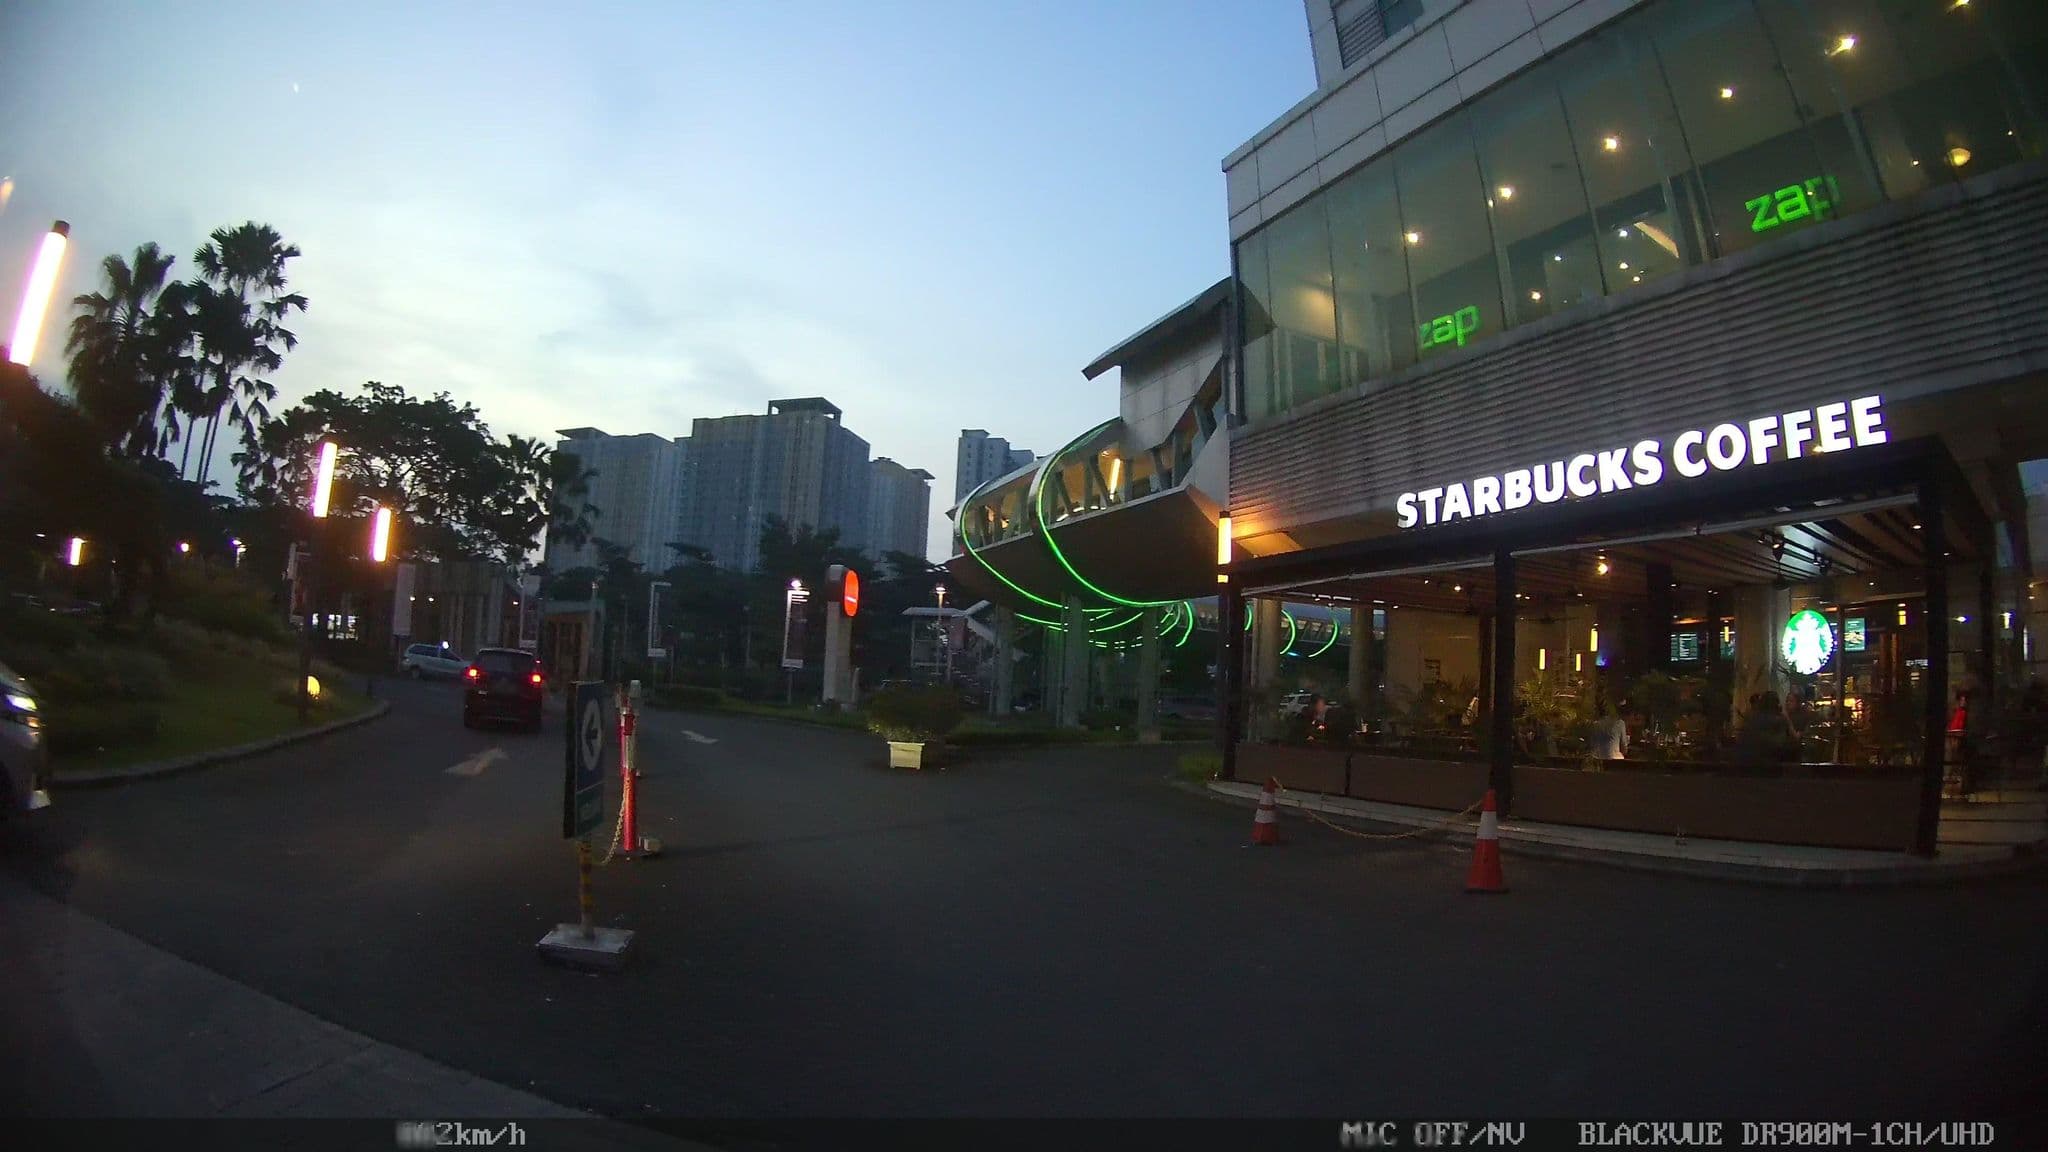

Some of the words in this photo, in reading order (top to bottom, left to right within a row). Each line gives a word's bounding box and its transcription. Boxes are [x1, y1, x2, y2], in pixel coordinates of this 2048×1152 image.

[1745, 175, 1839, 232] zap
[1420, 306, 1480, 348] zap
[1396, 440, 1664, 529] STARBUCKS
[1673, 395, 1888, 478] COFFEE
